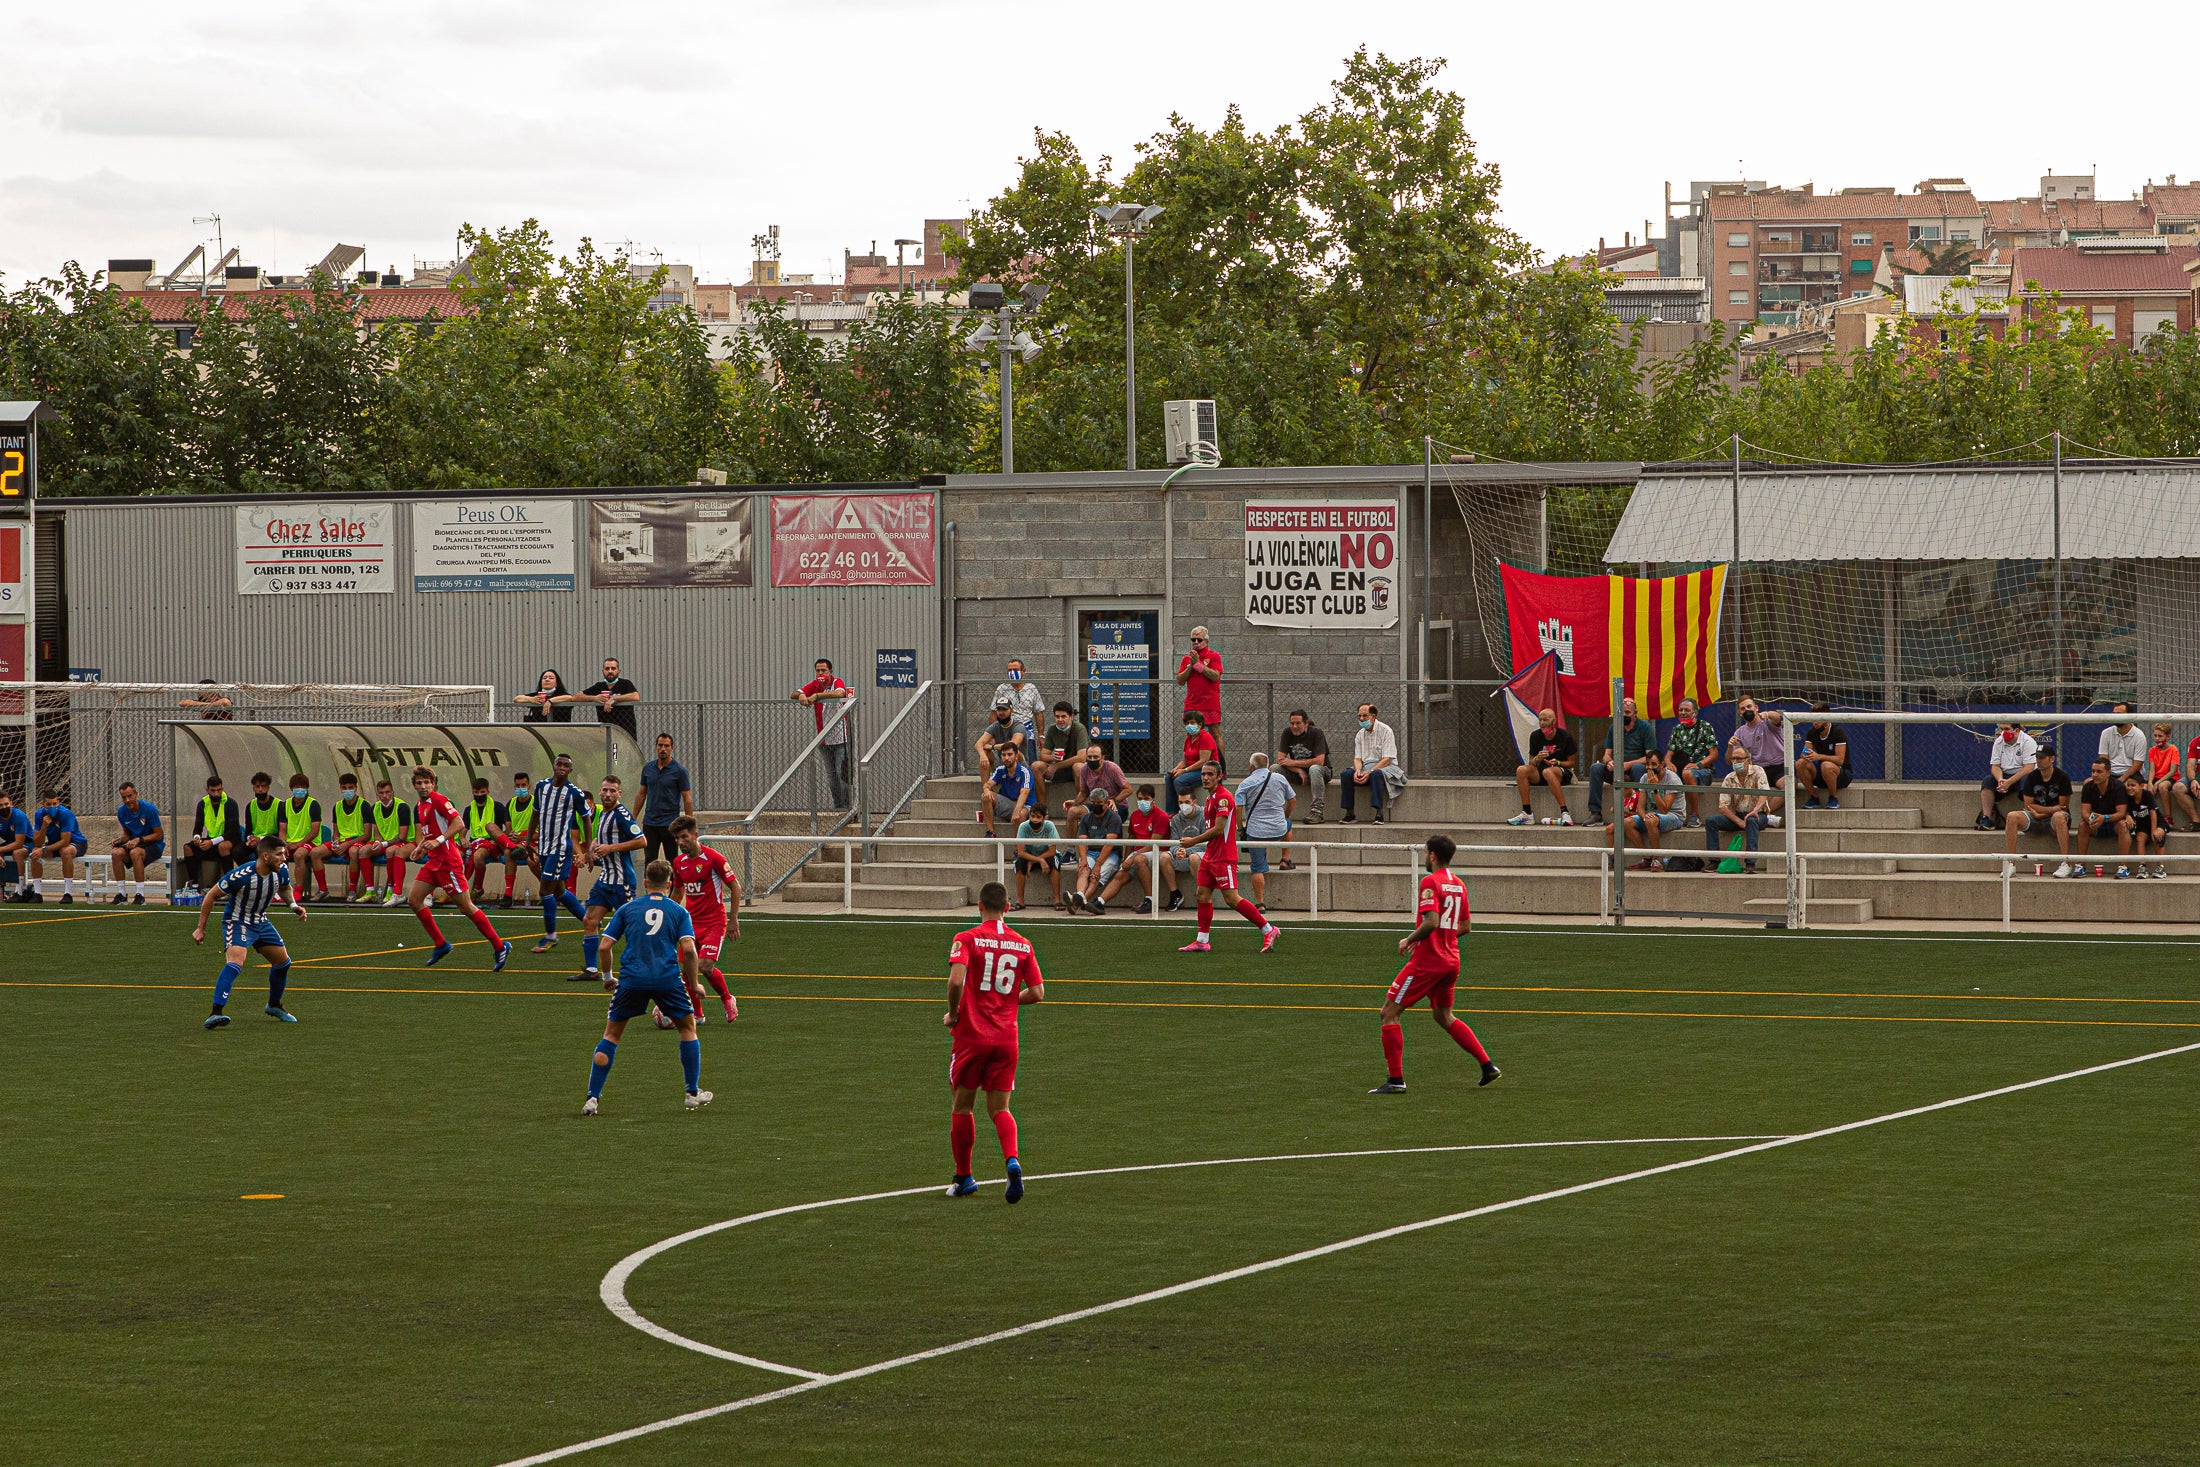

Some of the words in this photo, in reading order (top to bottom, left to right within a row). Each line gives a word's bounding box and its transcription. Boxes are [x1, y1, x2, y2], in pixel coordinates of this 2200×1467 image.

[0, 451, 24, 495] 2
[694, 501, 709, 509] Roc
[457, 506, 495, 523] Peus
[500, 505, 528, 522] OK
[1247, 511, 1308, 527] RESPECTE
[1310, 511, 1327, 527] EN
[1330, 511, 1344, 527] EL
[1347, 510, 1393, 527] FUTBOL
[818, 532, 876, 540] MANTENIMIENTO
[282, 549, 352, 559] PERRUQUERS
[1248, 540, 1265, 566] LA
[1268, 534, 1339, 567] VIOLÈNCIA
[1340, 533, 1394, 569] NO
[800, 551, 830, 568] 622
[834, 551, 856, 568] 46
[860, 551, 879, 567] 01
[886, 551, 907, 567] 22
[254, 566, 295, 575] CARRER
[299, 566, 318, 575] DEL
[322, 565, 355, 576] NORD,
[359, 565, 380, 574] 128
[800, 569, 907, 580] marsan93_@hotmail.com
[286, 581, 307, 590] 937
[310, 581, 332, 590] 833
[335, 581, 357, 589] 447
[417, 579, 439, 588] mòvil:
[440, 579, 452, 588] 696
[453, 579, 463, 587] 95
[463, 579, 472, 587] 47
[473, 579, 482, 587] 42
[1249, 571, 1322, 591] JUGA
[1330, 571, 1365, 590] EN
[0, 588, 12, 601] S
[1249, 595, 1316, 616] AQUEST
[1321, 595, 1366, 615] CLUB
[878, 654, 898, 664] BAR
[84, 672, 99, 682] WC
[897, 673, 914, 684] WC
[1439, 895, 1462, 930] 21
[644, 908, 664, 936] 9
[974, 937, 999, 949] VICTOR
[1000, 940, 1031, 953] MORALES
[979, 951, 1018, 995] 16
